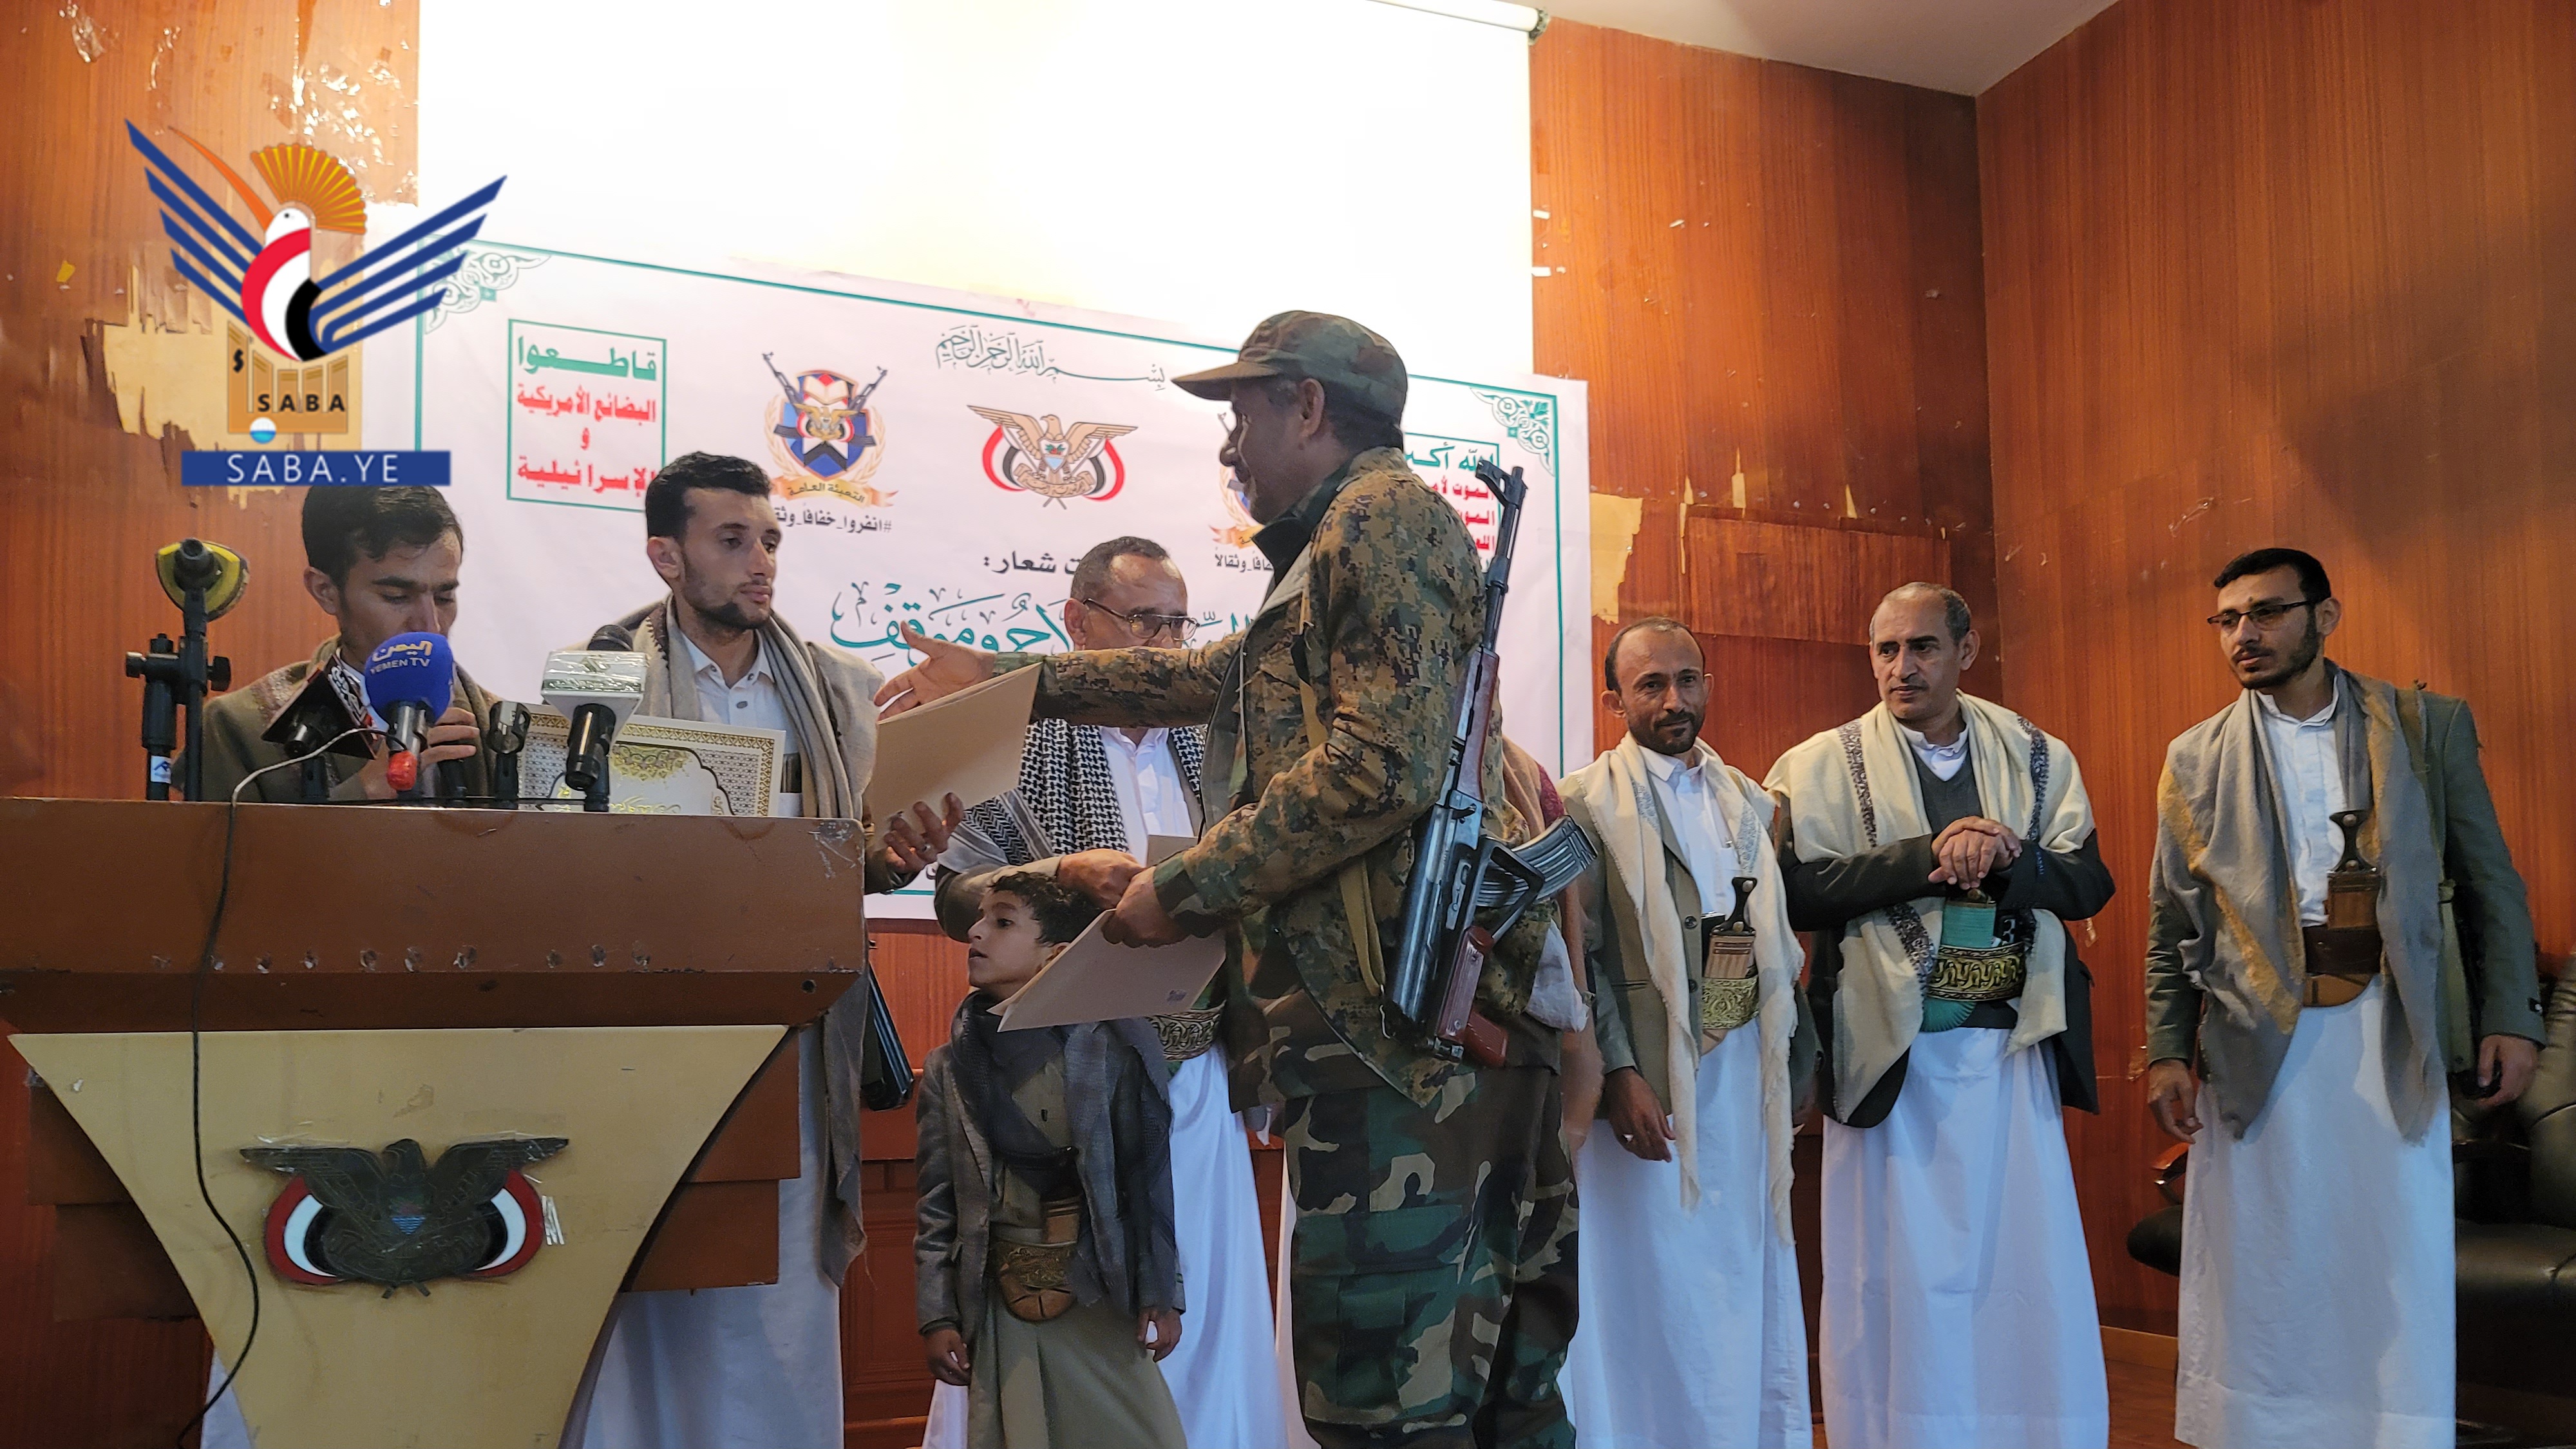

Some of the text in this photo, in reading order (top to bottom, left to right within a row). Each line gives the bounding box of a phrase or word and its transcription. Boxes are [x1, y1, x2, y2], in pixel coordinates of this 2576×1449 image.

[516, 383, 656, 426] البضائع الأمريكية
[580, 427, 591, 451] و
[786, 482, 866, 504] التعبئة العامة
[372, 640, 433, 662] اليمن
[409, 657, 431, 667] TV
